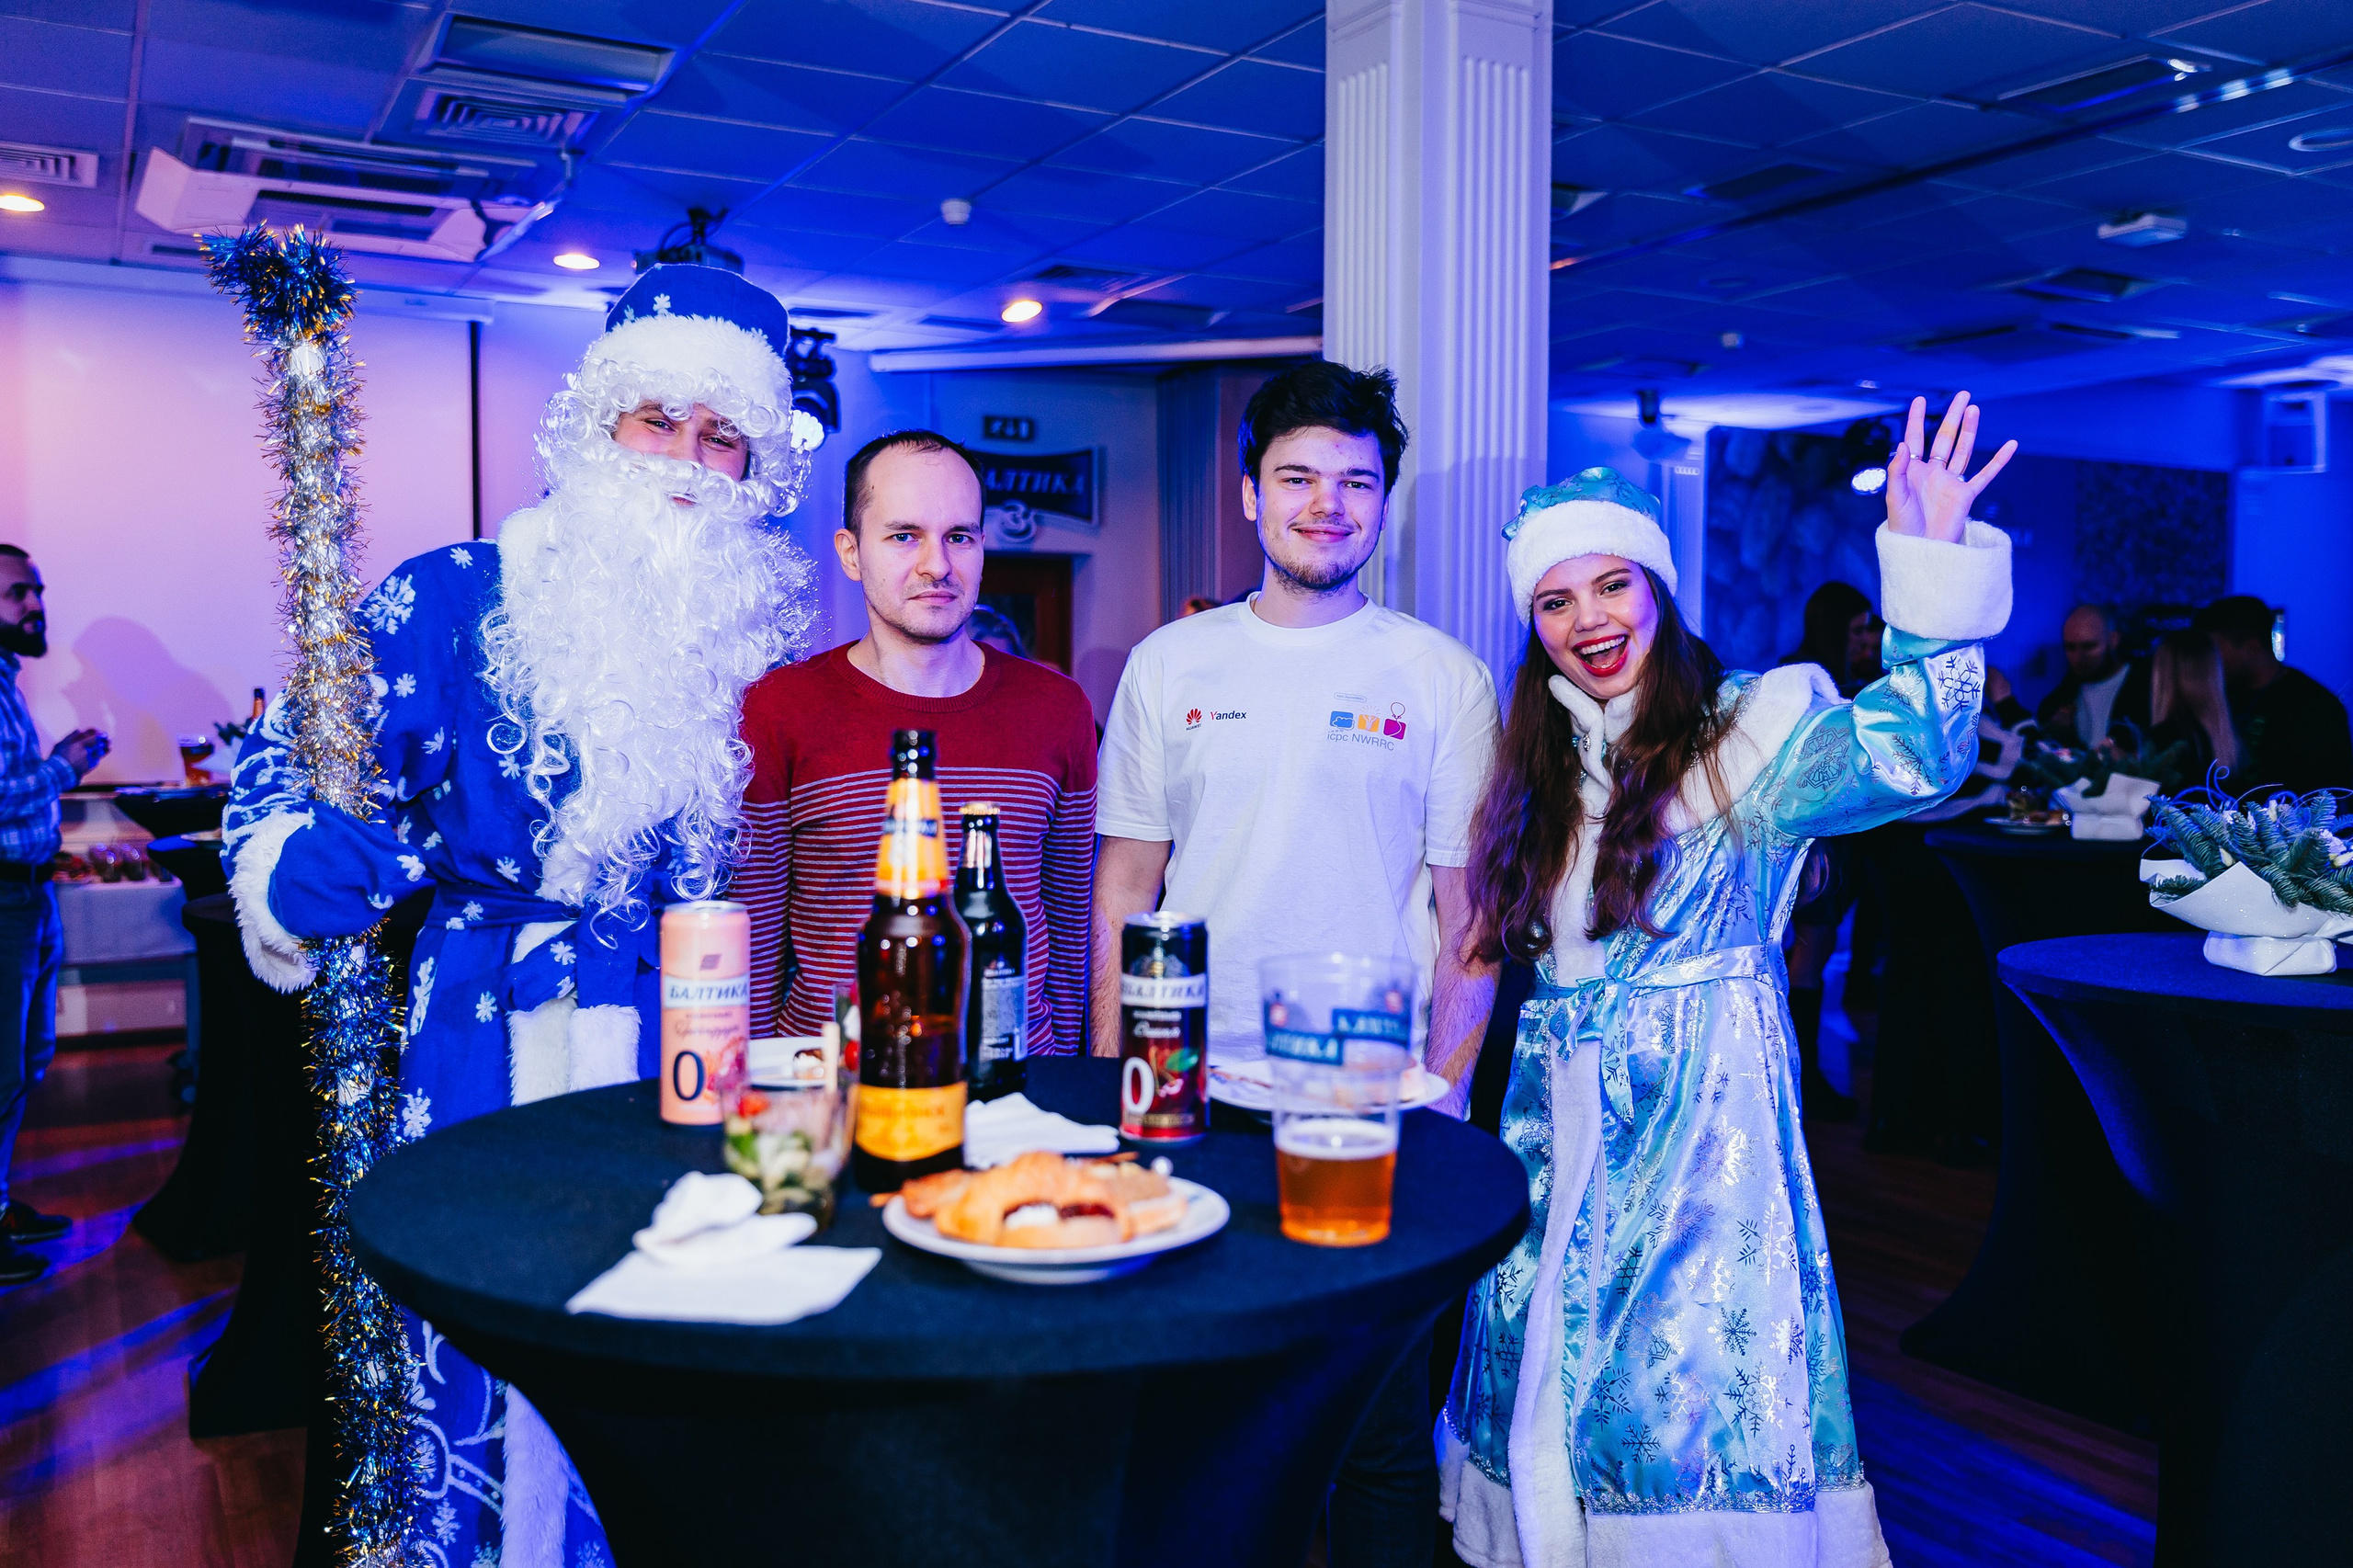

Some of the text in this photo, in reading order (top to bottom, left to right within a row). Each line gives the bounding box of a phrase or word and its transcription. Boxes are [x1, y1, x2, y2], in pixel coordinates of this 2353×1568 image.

[983, 468, 1086, 495] АЛТИКА
[1210, 710, 1247, 721] Yandex
[1326, 732, 1395, 752] icpc NWRRC
[669, 981, 749, 1000] БАЛТИКА
[673, 1051, 705, 1101] 0
[1121, 1057, 1155, 1115] 0
